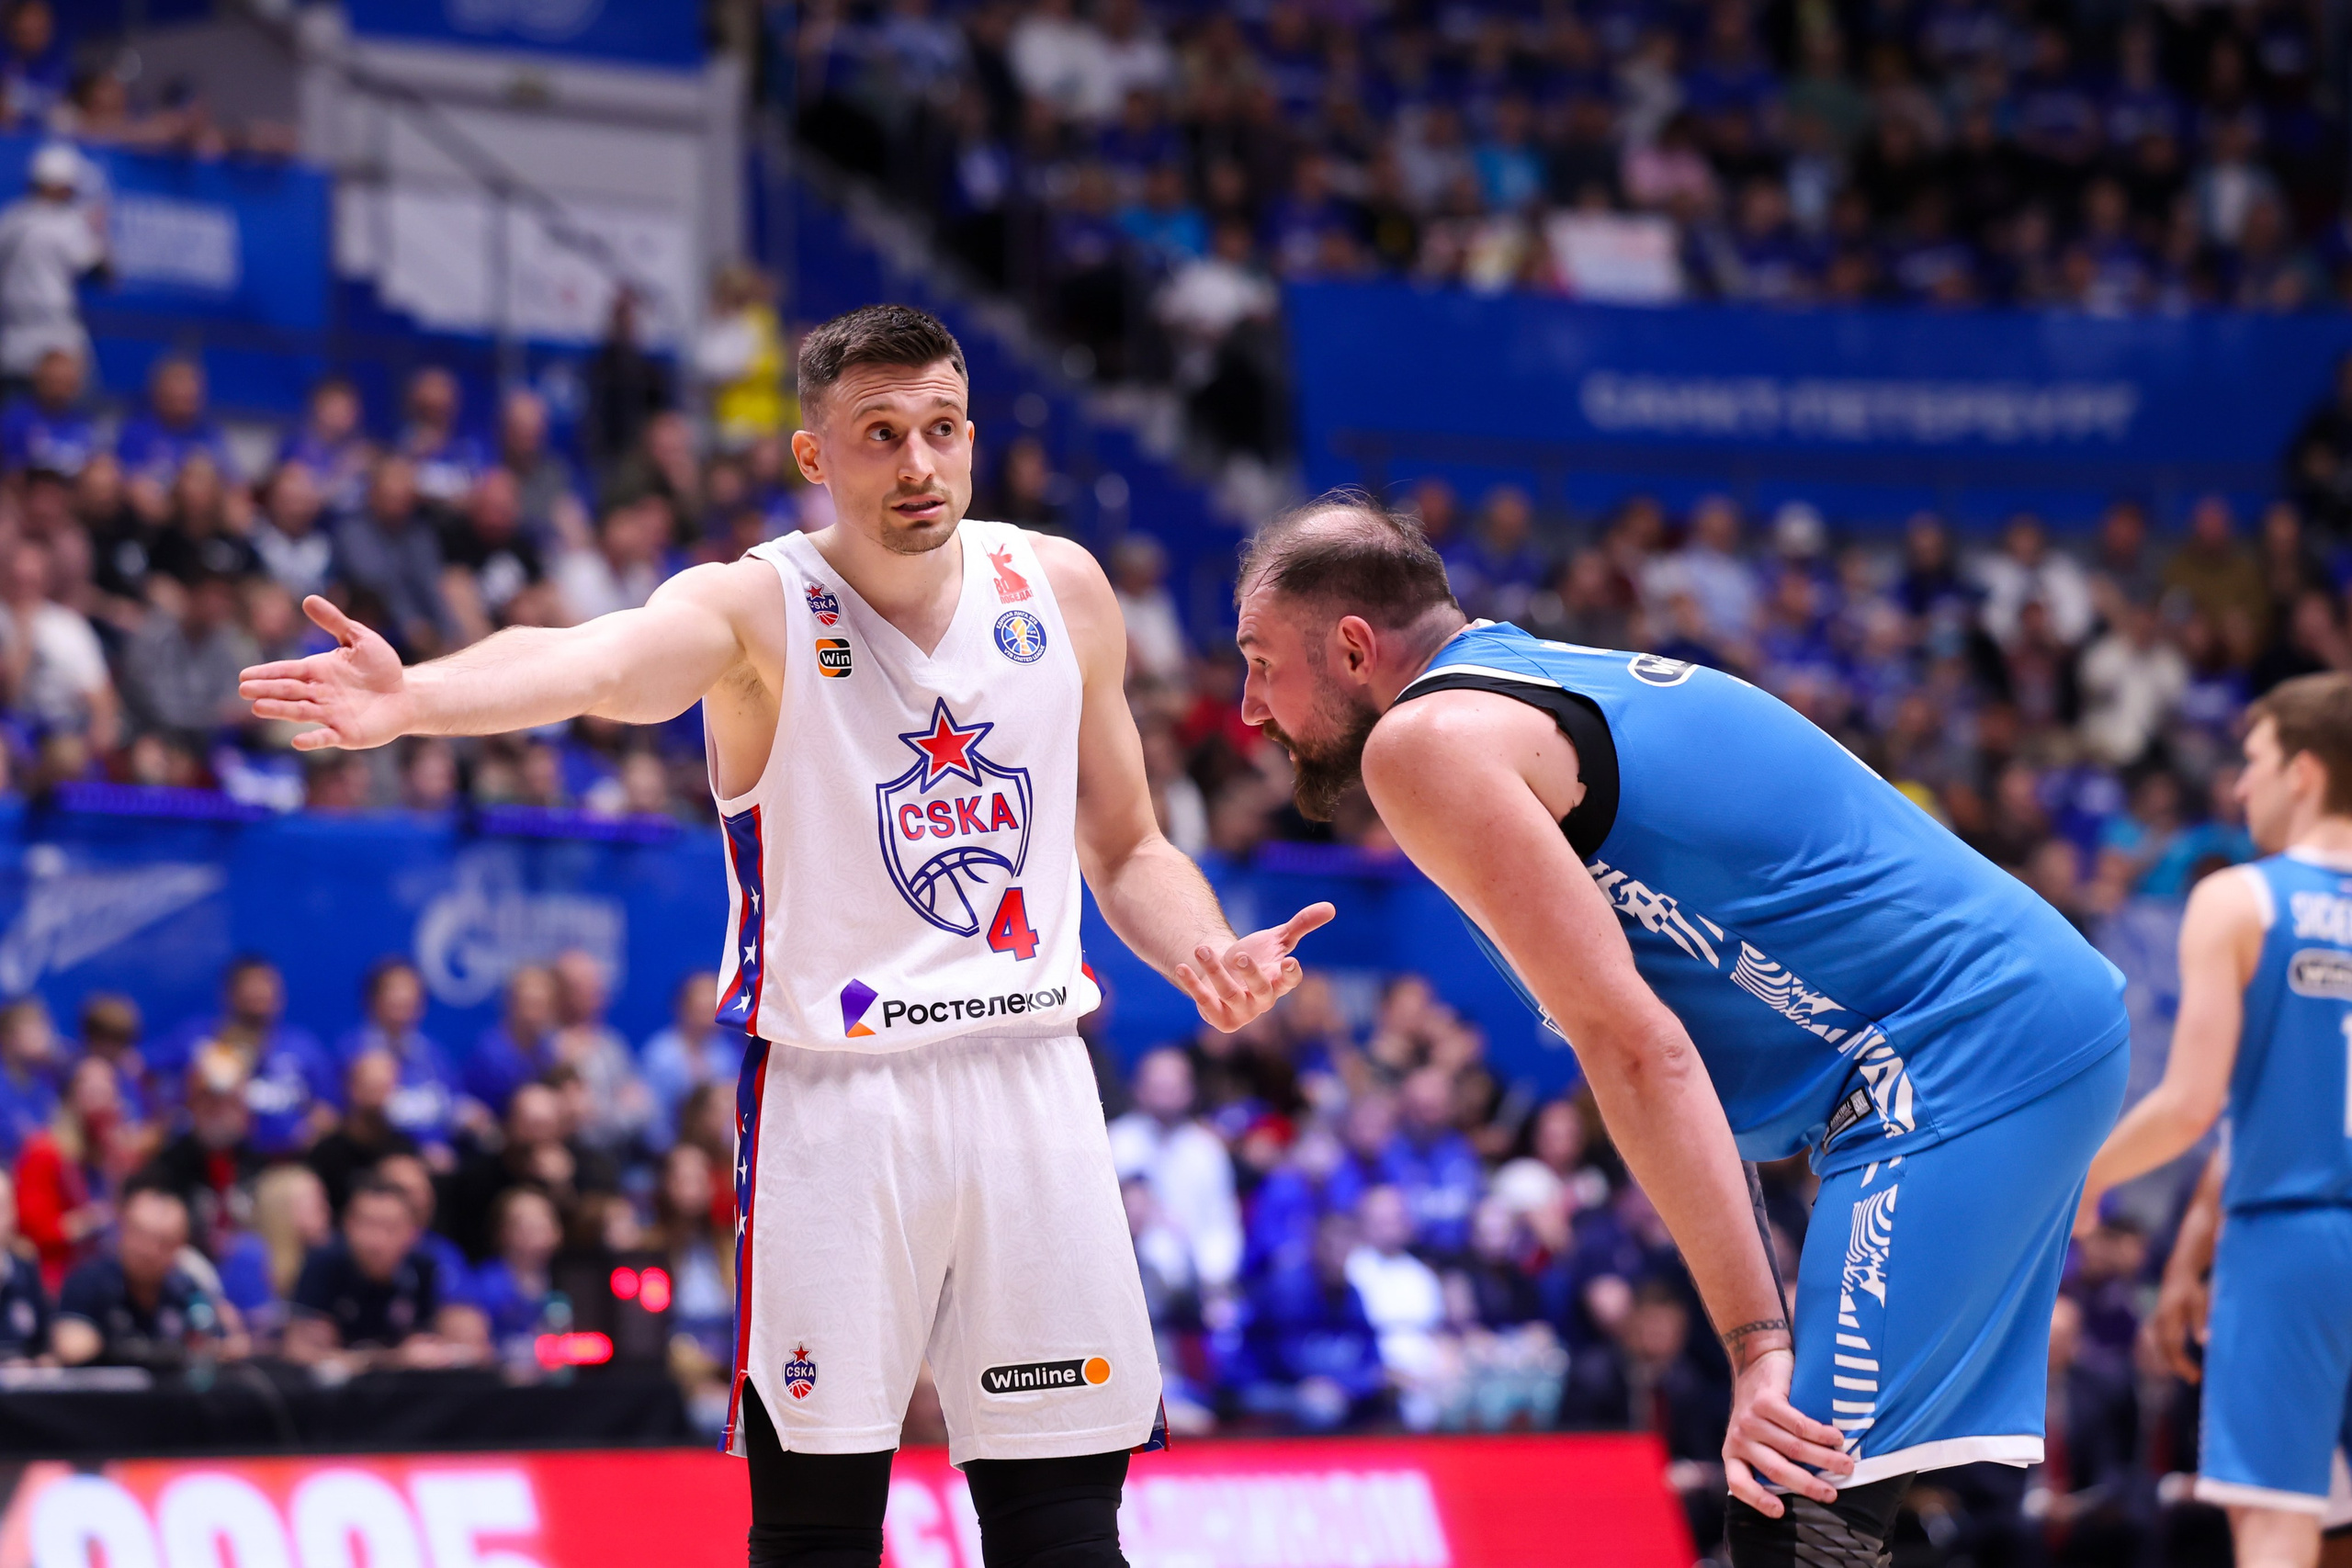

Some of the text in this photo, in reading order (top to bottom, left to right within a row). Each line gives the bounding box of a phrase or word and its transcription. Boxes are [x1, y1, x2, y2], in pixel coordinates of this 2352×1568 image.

[808, 598, 836, 610] CSKA
[1000, 590, 1034, 604] ПОБЕДА!
[996, 612, 1014, 629] ЕДИНАЯ
[1013, 611, 1029, 619] ЛИГА
[821, 652, 851, 665] Win
[1003, 649, 1014, 659] VTB
[1033, 644, 1046, 660] LEAGUE
[898, 792, 1020, 841] CSKA
[986, 886, 1040, 962] 4
[884, 986, 1068, 1028] Ростелеком
[786, 1364, 815, 1378] CSKA
[989, 1365, 1078, 1388] Winline
